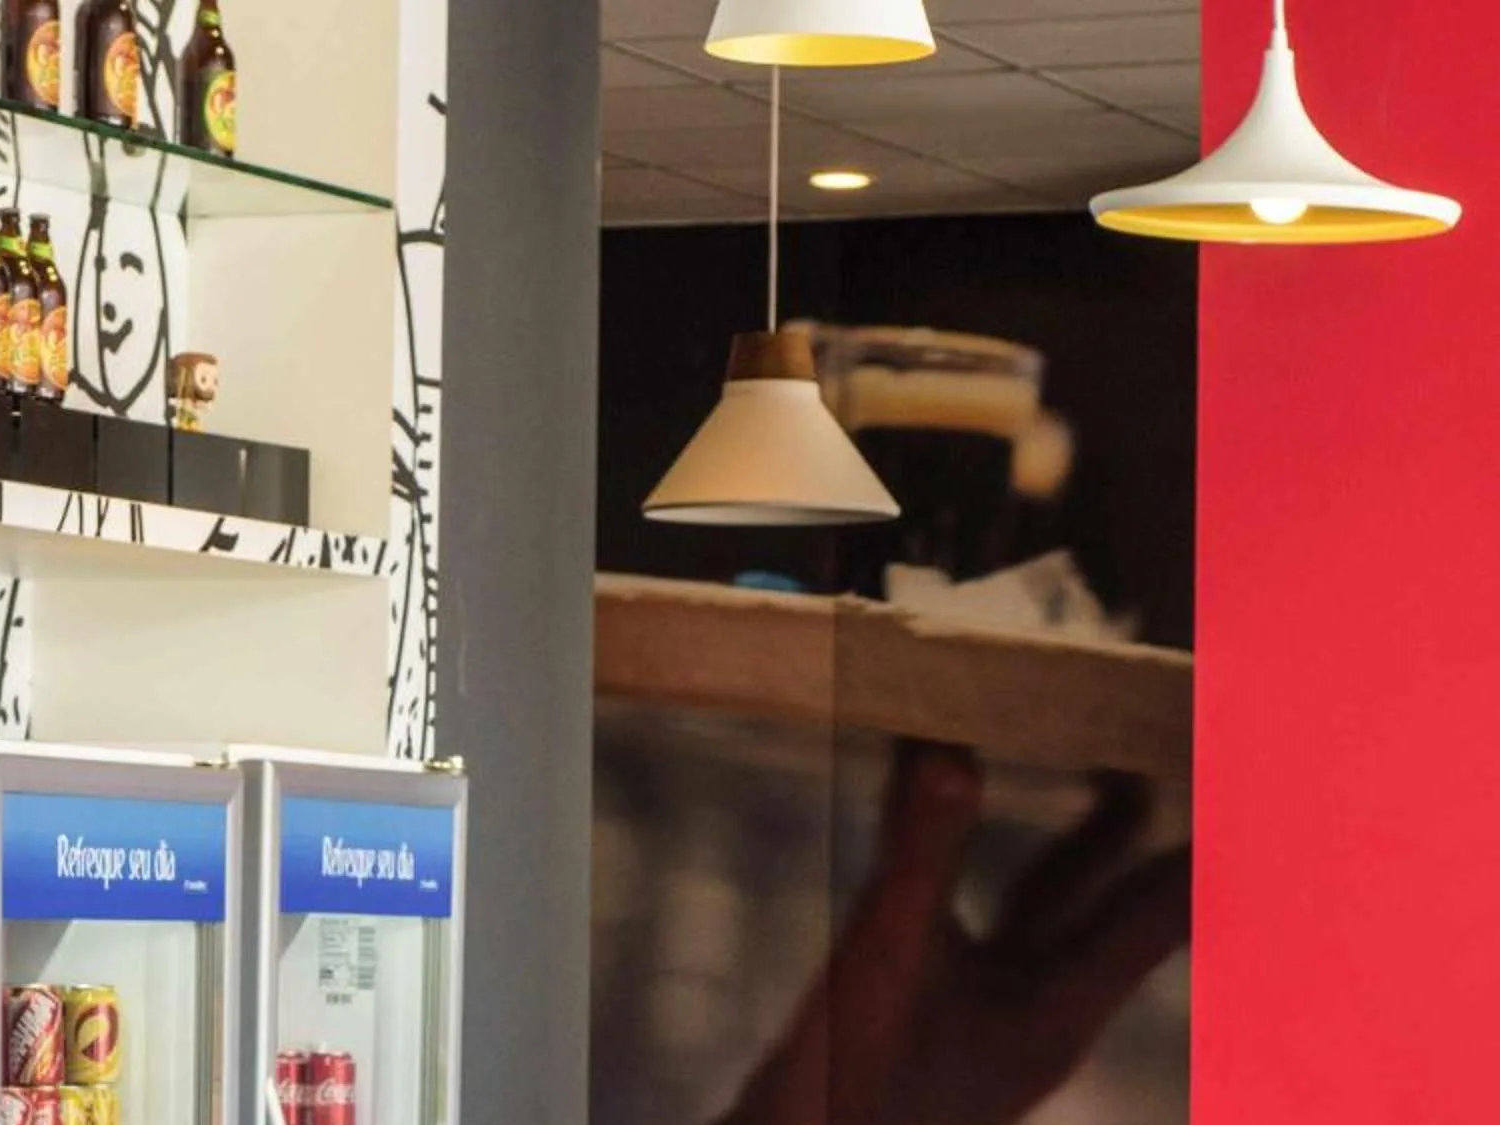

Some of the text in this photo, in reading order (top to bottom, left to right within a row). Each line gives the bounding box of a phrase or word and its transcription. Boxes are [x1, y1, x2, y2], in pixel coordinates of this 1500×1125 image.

[57, 833, 176, 890] Refresque seu dia
[322, 835, 415, 888] Refresque seu dia
